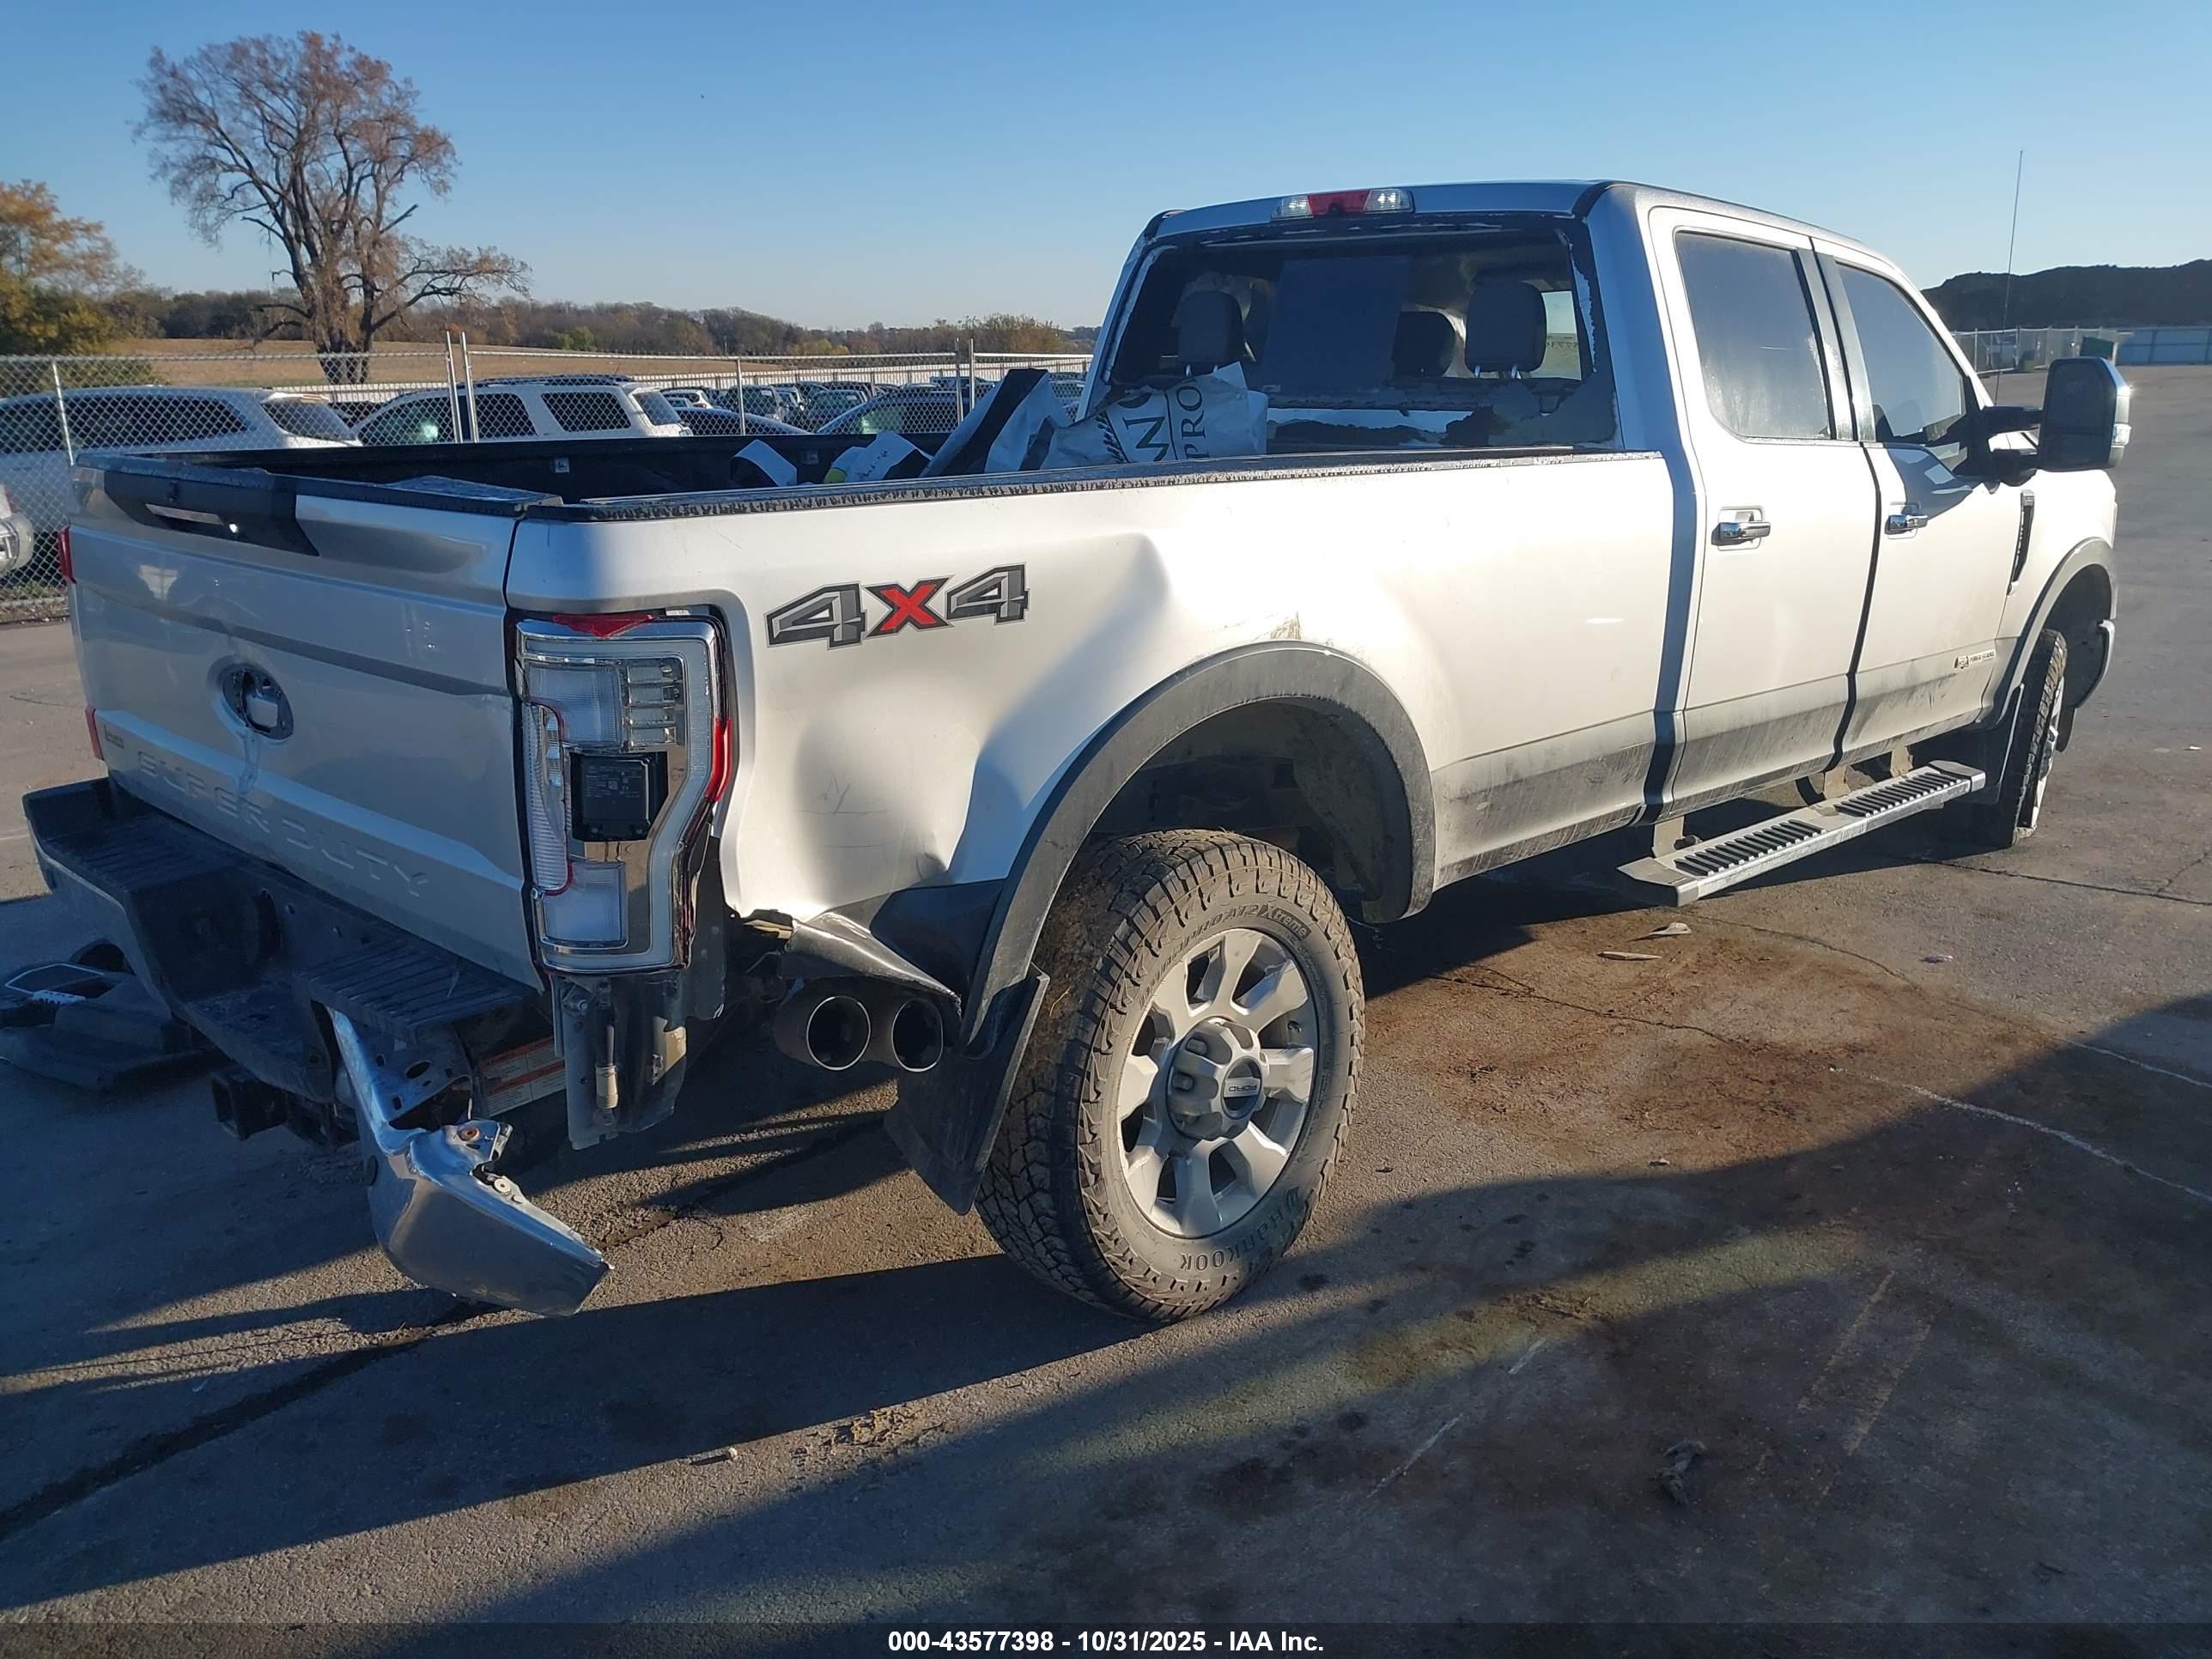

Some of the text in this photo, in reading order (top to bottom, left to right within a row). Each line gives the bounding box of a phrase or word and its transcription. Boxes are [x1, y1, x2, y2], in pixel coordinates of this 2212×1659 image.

[1176, 378, 1210, 459] PRO
[137, 750, 429, 897] SUPER DUTY
[1261, 902, 1307, 939] Xtreme
